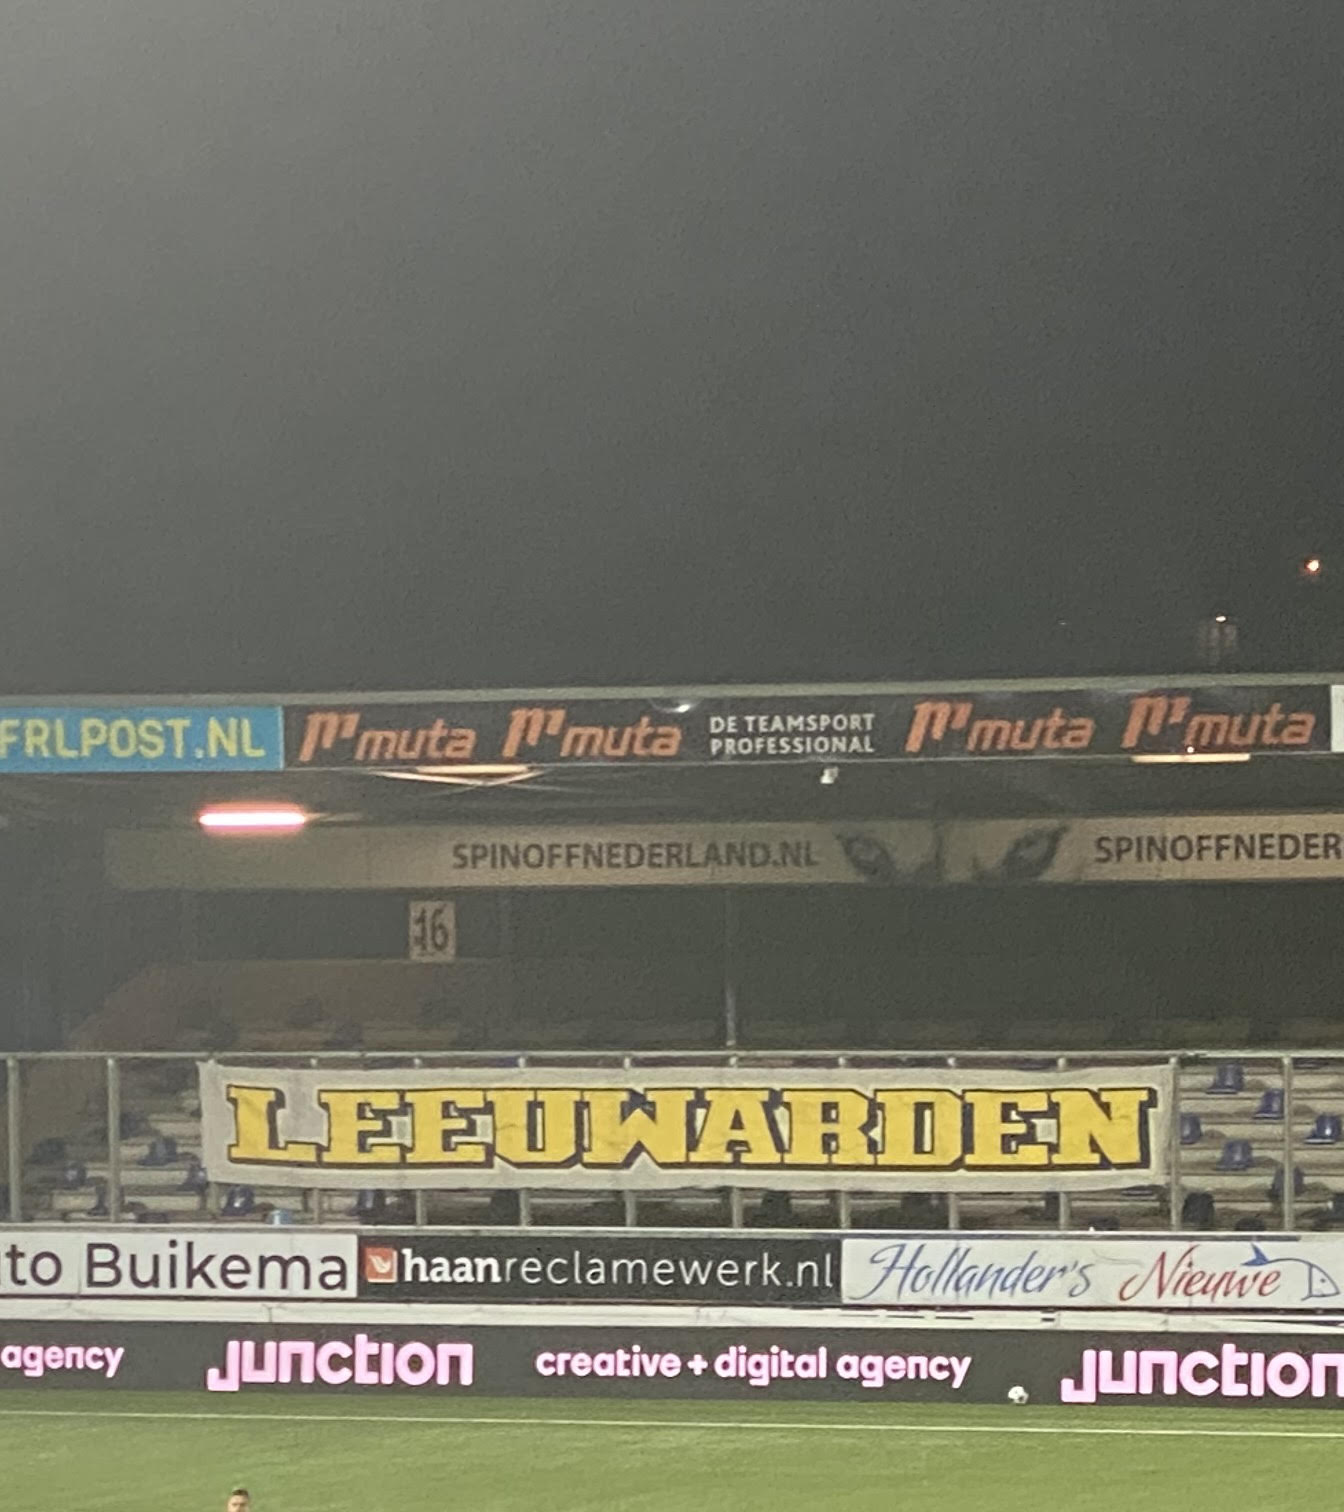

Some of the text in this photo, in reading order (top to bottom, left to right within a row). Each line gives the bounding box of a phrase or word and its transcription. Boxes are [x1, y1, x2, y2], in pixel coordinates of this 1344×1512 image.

[357, 719, 477, 761] muta
[560, 716, 682, 758] muta
[709, 713, 875, 733] DE TEAMSPORT
[967, 708, 1095, 752] muta
[1184, 703, 1316, 746] muta
[709, 734, 875, 756] PROFESSIONAL
[452, 841, 821, 870] SPINOFFNEDERLAND.NL
[413, 906, 450, 953] 16
[226, 1084, 1158, 1171] LEEUWARDEN
[86, 1239, 349, 1292] Buikema
[403, 1248, 834, 1289] haanreclamewerk.nl
[859, 1242, 1282, 1302] Hollander's Nieuwe
[1, 1344, 125, 1378] agency
[535, 1344, 682, 1378] creative
[714, 1345, 827, 1386] digital
[836, 1353, 972, 1389] agency
